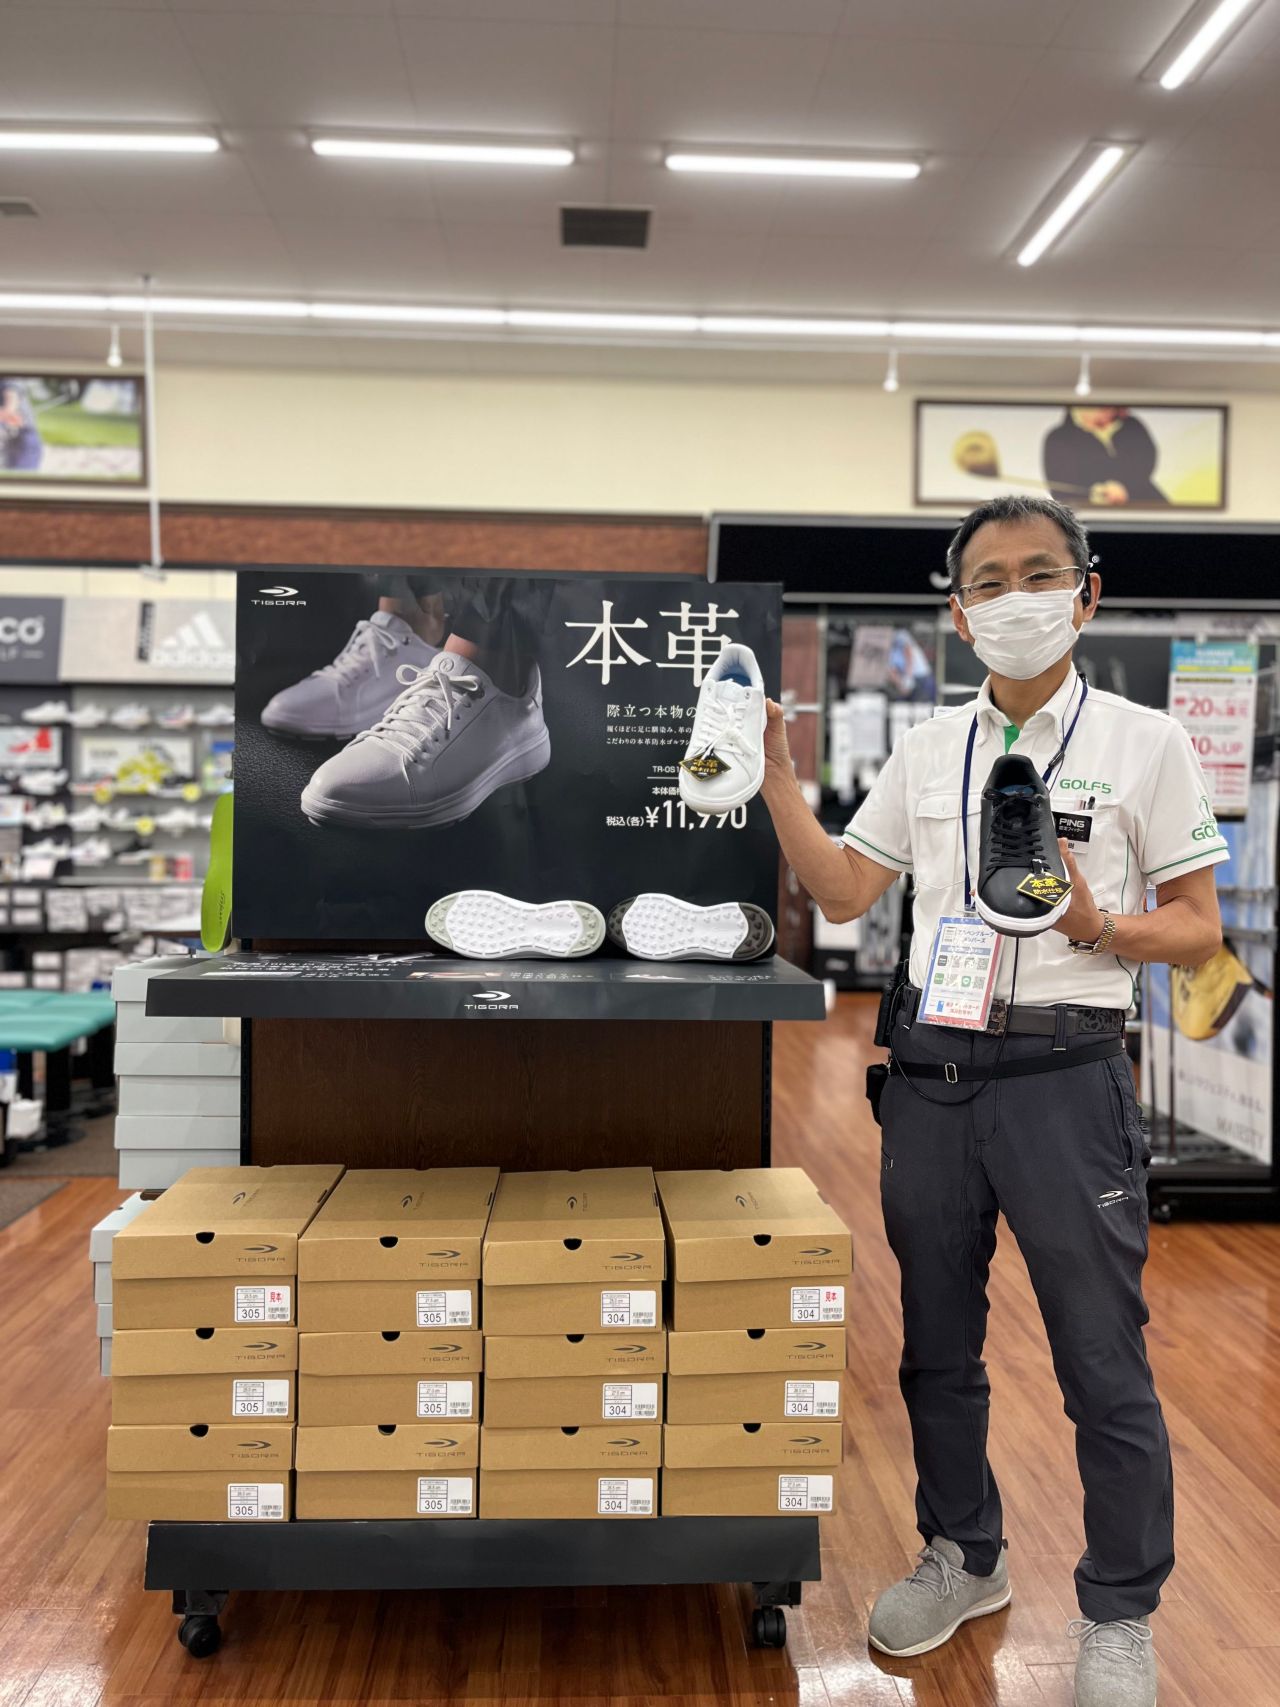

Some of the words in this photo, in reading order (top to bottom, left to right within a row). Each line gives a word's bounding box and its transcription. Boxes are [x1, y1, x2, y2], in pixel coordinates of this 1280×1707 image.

[565, 600, 739, 687] 本革
[606, 703, 697, 719] 際立つ本物の
[1059, 817, 1086, 828] PING
[240, 1308, 261, 1321] 305
[423, 1312, 442, 1324] 305
[607, 1313, 625, 1324] 304
[797, 1309, 815, 1320] 304
[240, 1402, 259, 1413] 305
[423, 1403, 442, 1414] 305
[609, 1405, 627, 1416] 304
[791, 1402, 809, 1413] 304
[424, 1499, 443, 1510] 305
[604, 1500, 622, 1511] 304
[784, 1498, 804, 1510] 304
[233, 1505, 254, 1516] 305
